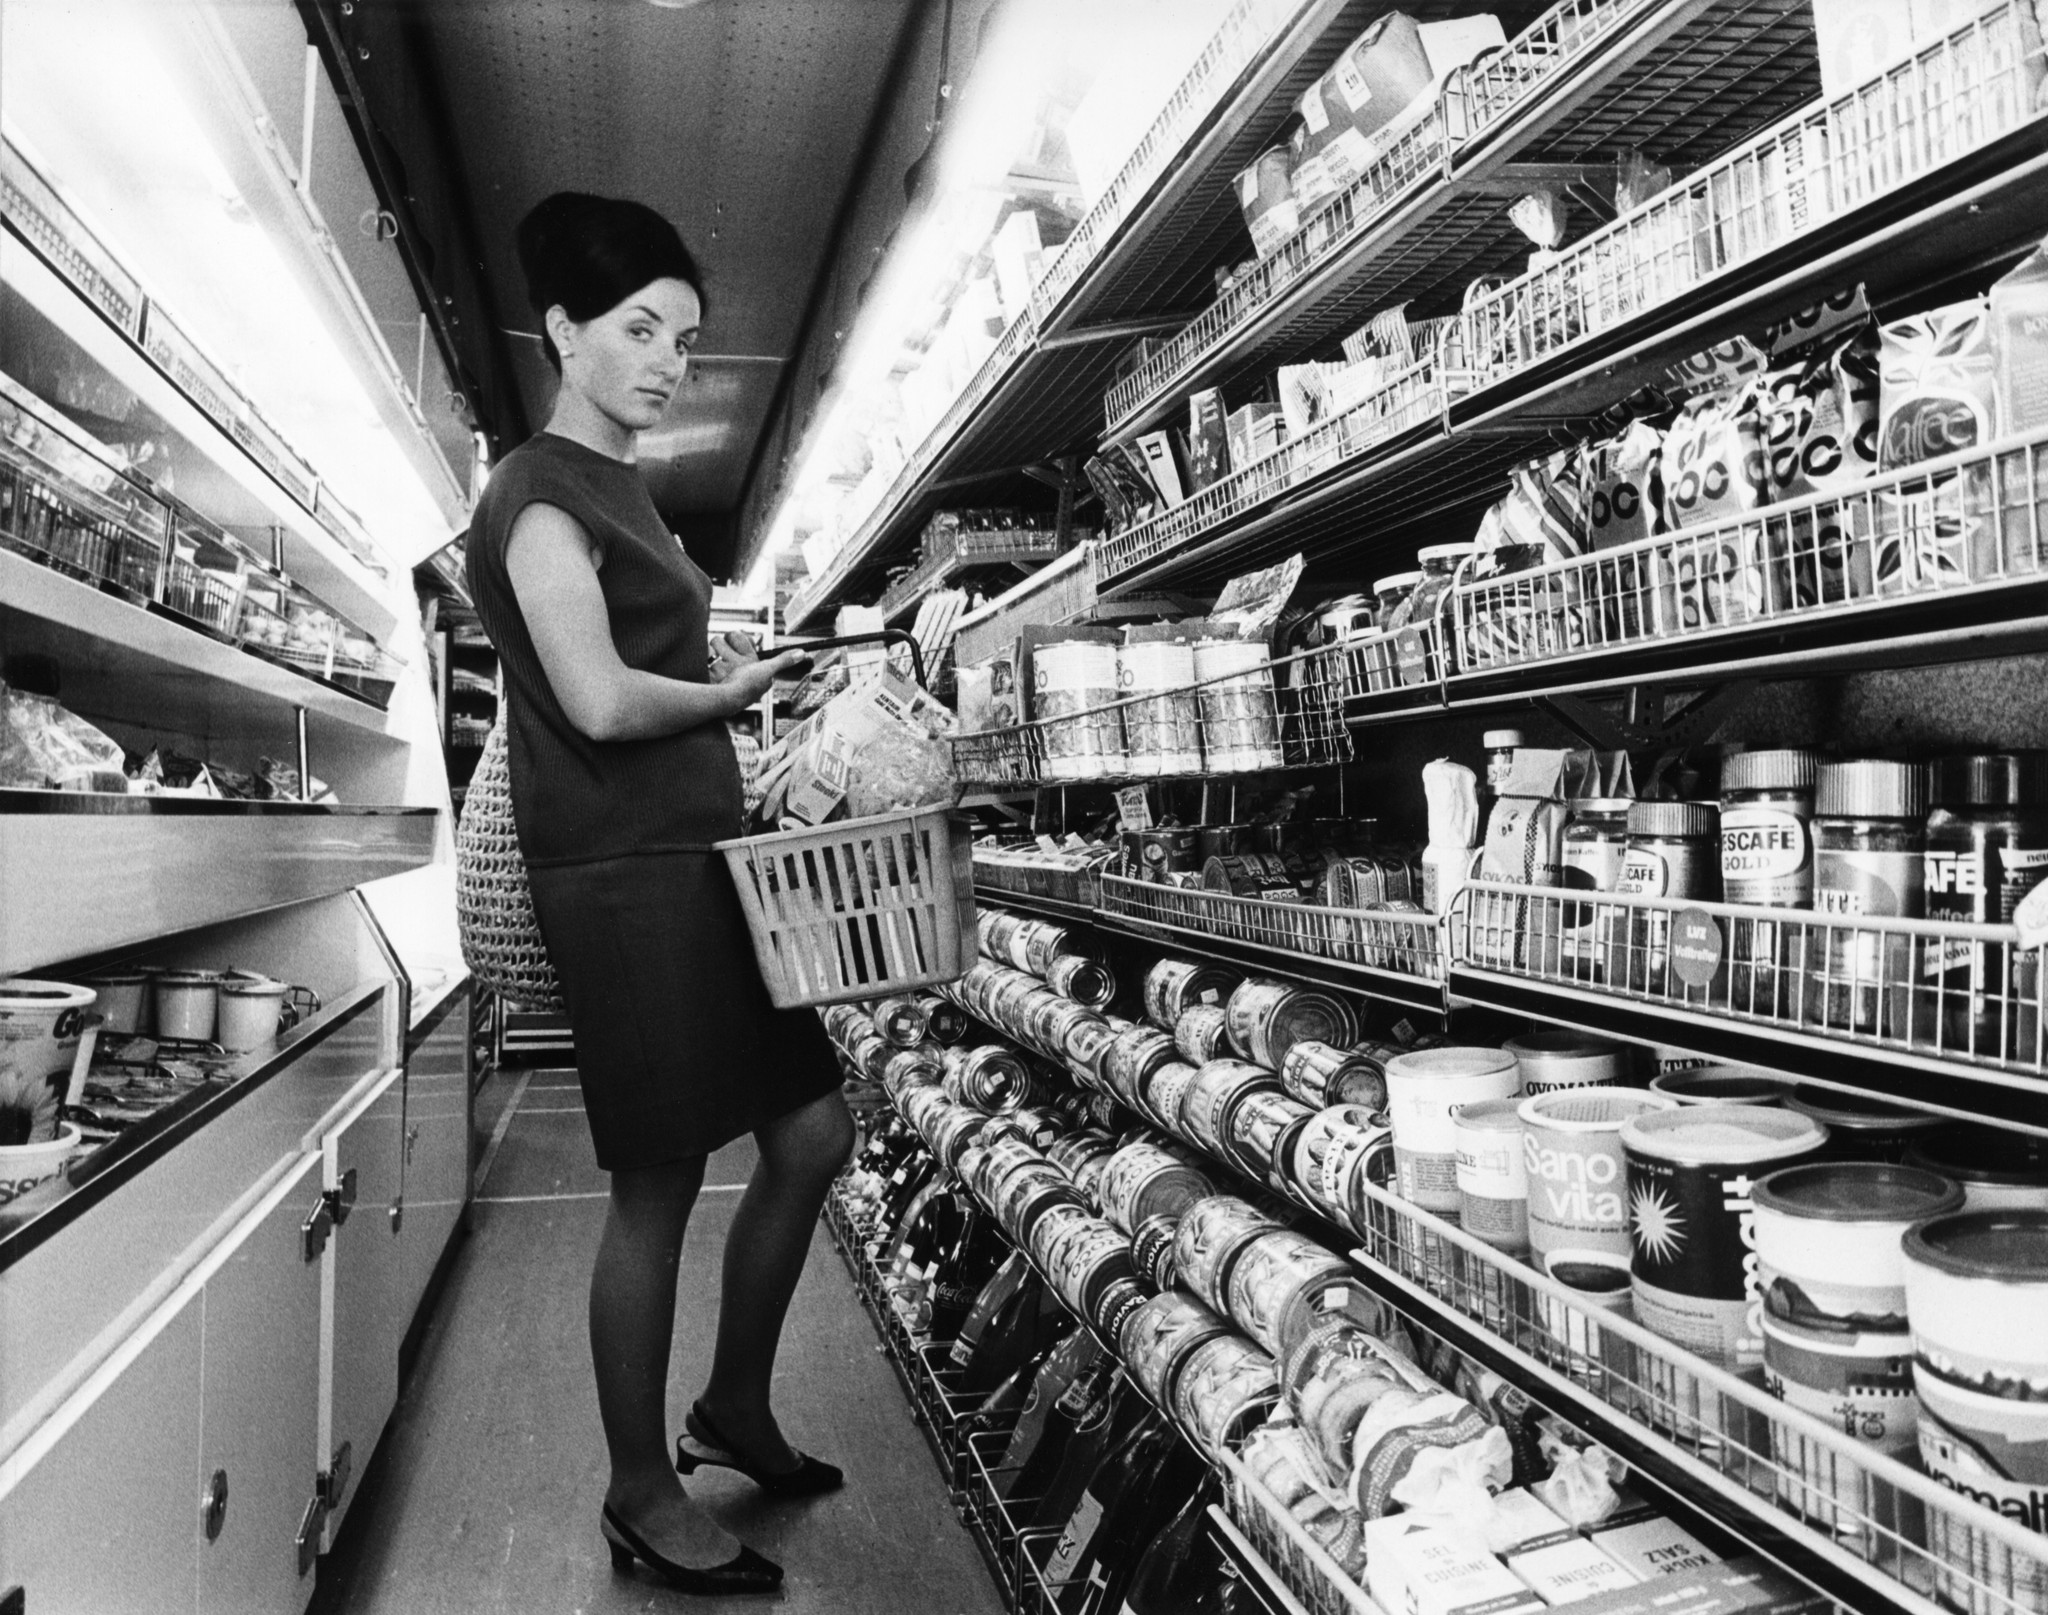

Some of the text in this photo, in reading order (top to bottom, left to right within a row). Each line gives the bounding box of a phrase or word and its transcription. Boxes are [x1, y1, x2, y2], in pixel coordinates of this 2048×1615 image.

[1524, 1132, 1617, 1184] Sano
[1547, 1182, 1623, 1222] vita
[1642, 1543, 1690, 1564] SALZ
